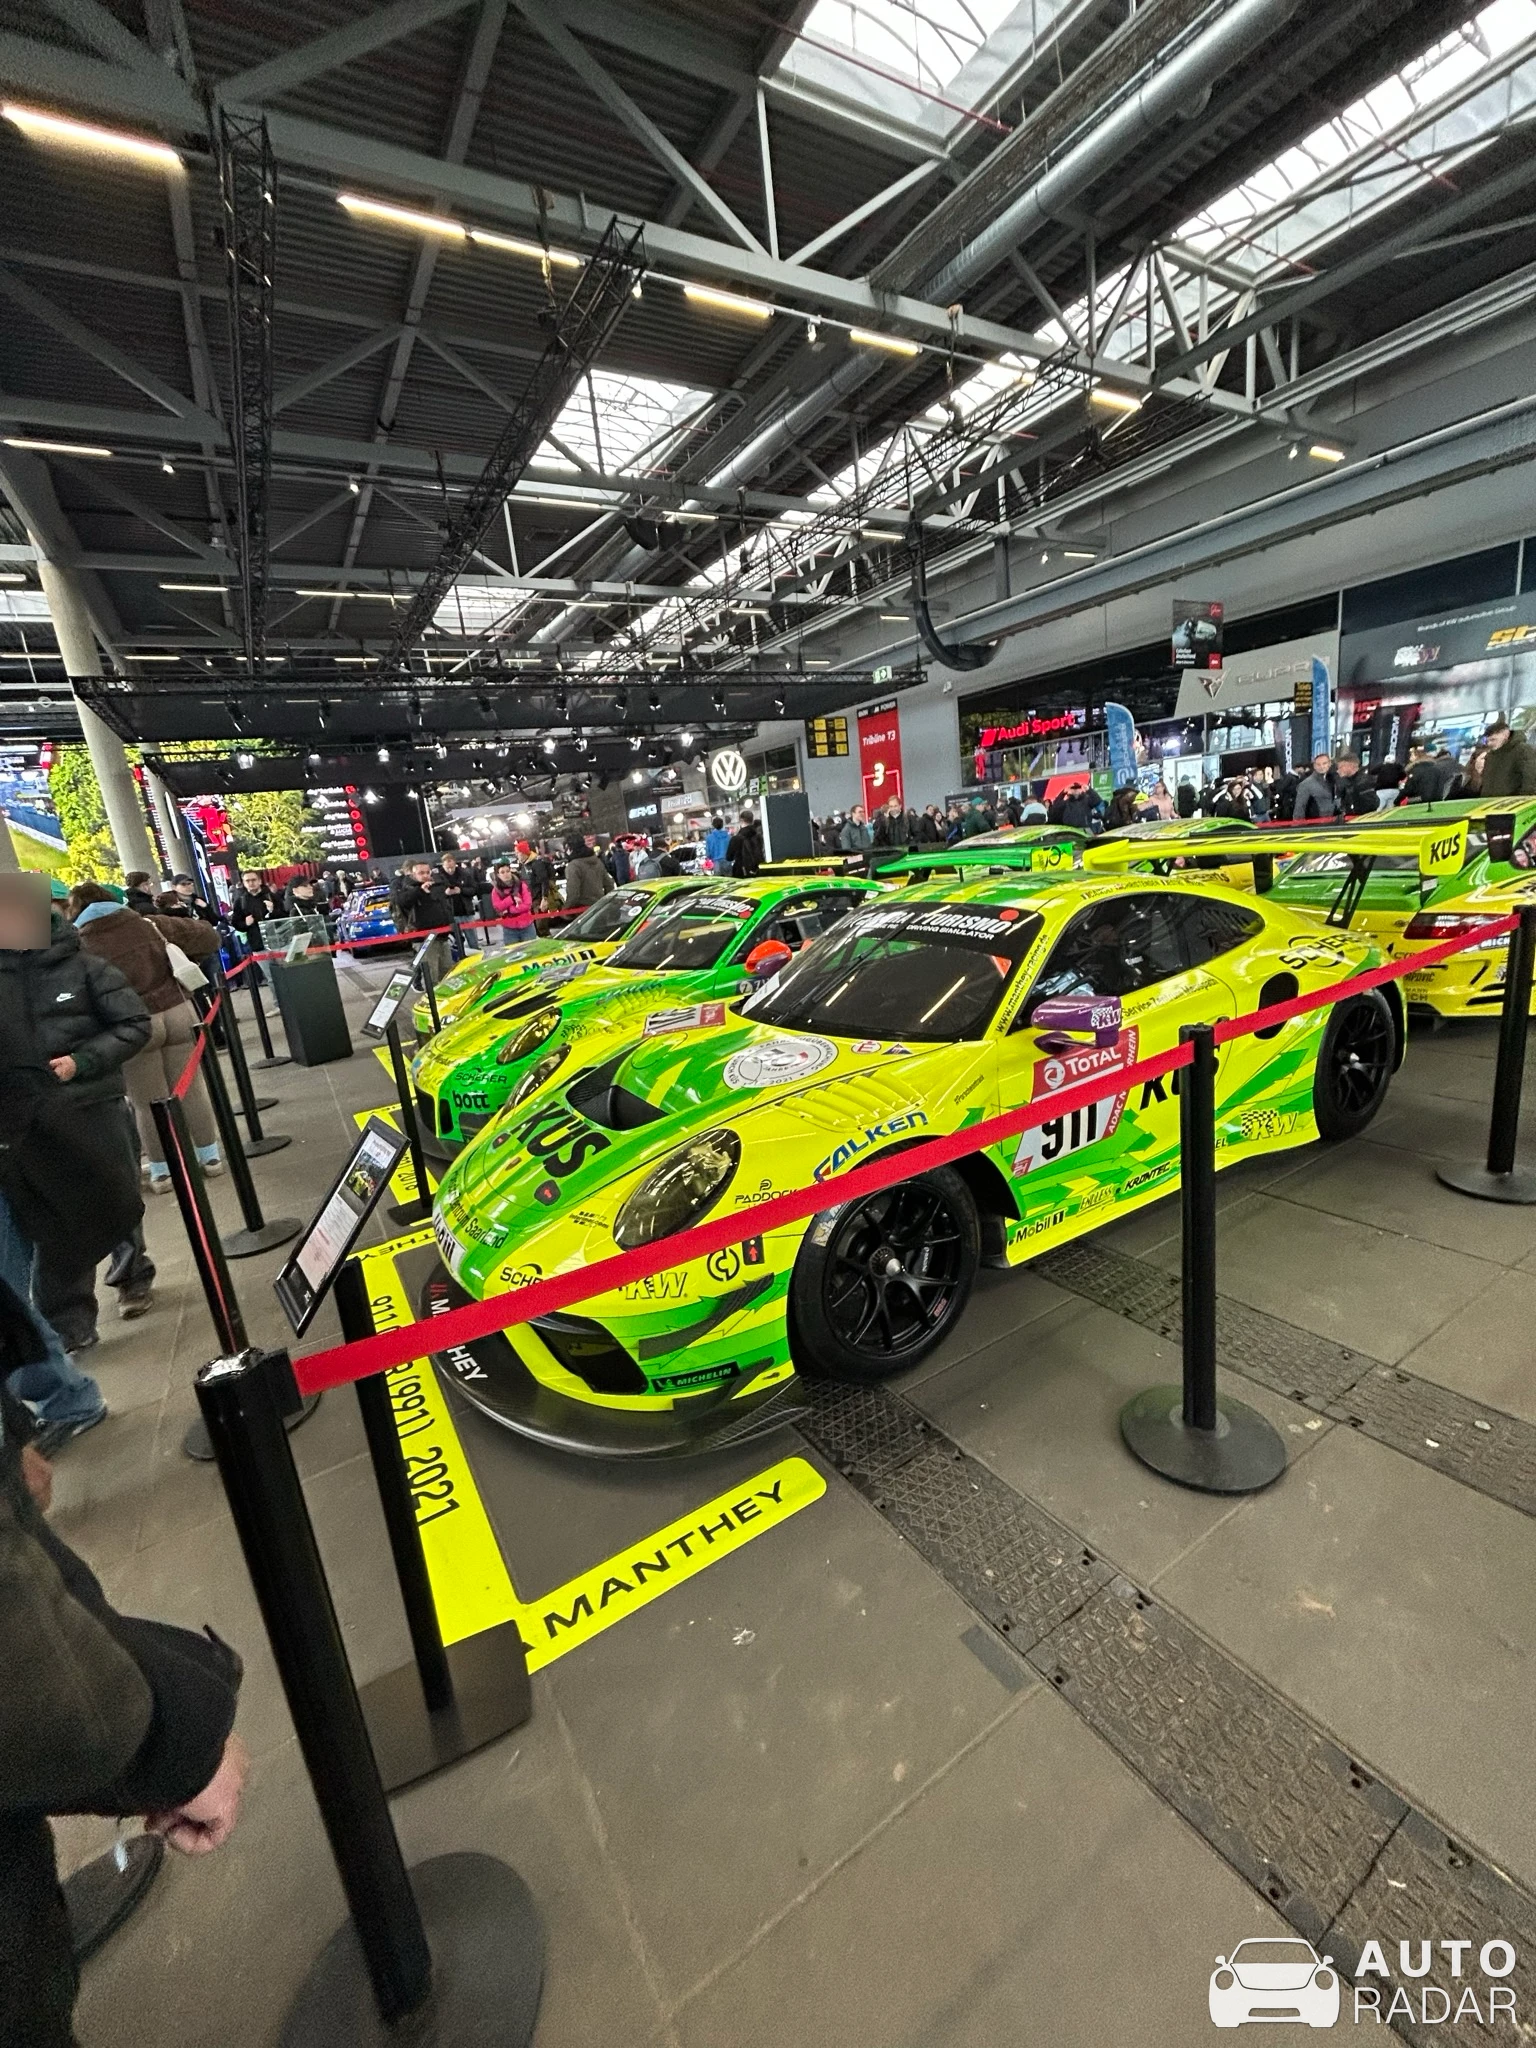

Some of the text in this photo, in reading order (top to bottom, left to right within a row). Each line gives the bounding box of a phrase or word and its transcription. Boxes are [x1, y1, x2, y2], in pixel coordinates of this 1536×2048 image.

[998, 713, 1076, 741] Audi Sport
[872, 762, 885, 787] 3
[905, 924, 940, 933] DRIVING
[938, 926, 995, 941] SIMULATOR
[521, 953, 578, 973] Mobil
[995, 933, 1050, 1033] www.manthey-racing.de
[1065, 1047, 1122, 1077] TOTAL
[451, 1090, 491, 1110] bott
[1041, 1101, 1098, 1161] 911
[813, 1110, 929, 1184] FALKEN
[1124, 1161, 1171, 1191] KRONTEC
[1015, 1209, 1065, 1243] Mobil 1
[625, 1271, 688, 1301] KW
[371, 1295, 398, 1324] 911
[675, 1366, 733, 1387] MICHELIN
[388, 1374, 436, 1440] (991)
[404, 1446, 461, 1527] 2021
[542, 1480, 783, 1640] MANTHEY
